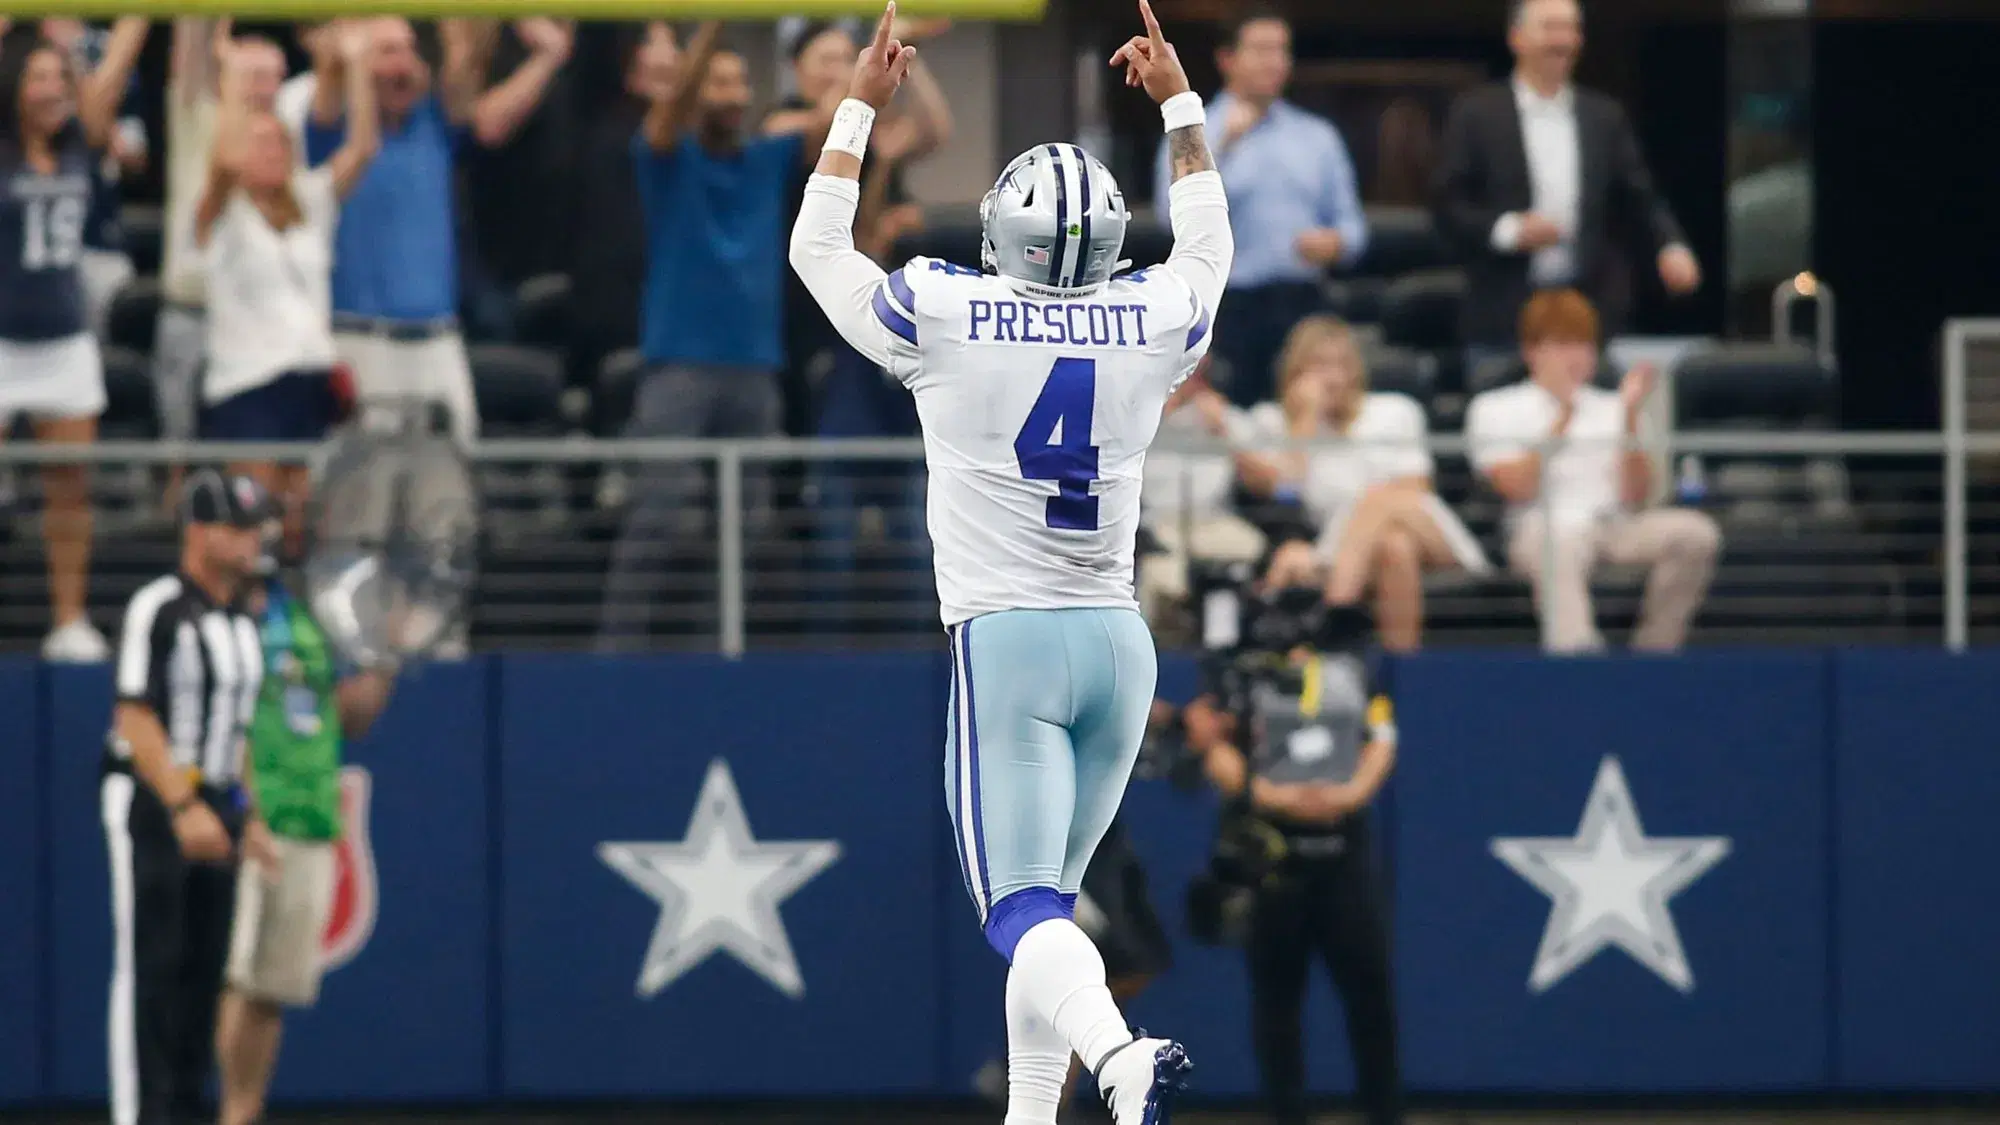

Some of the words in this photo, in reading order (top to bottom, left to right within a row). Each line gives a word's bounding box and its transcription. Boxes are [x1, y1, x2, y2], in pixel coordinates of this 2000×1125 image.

[1025, 285, 1062, 298] INSPIRE
[968, 300, 1147, 346] PRESCOTT
[1014, 357, 1099, 530] 4
